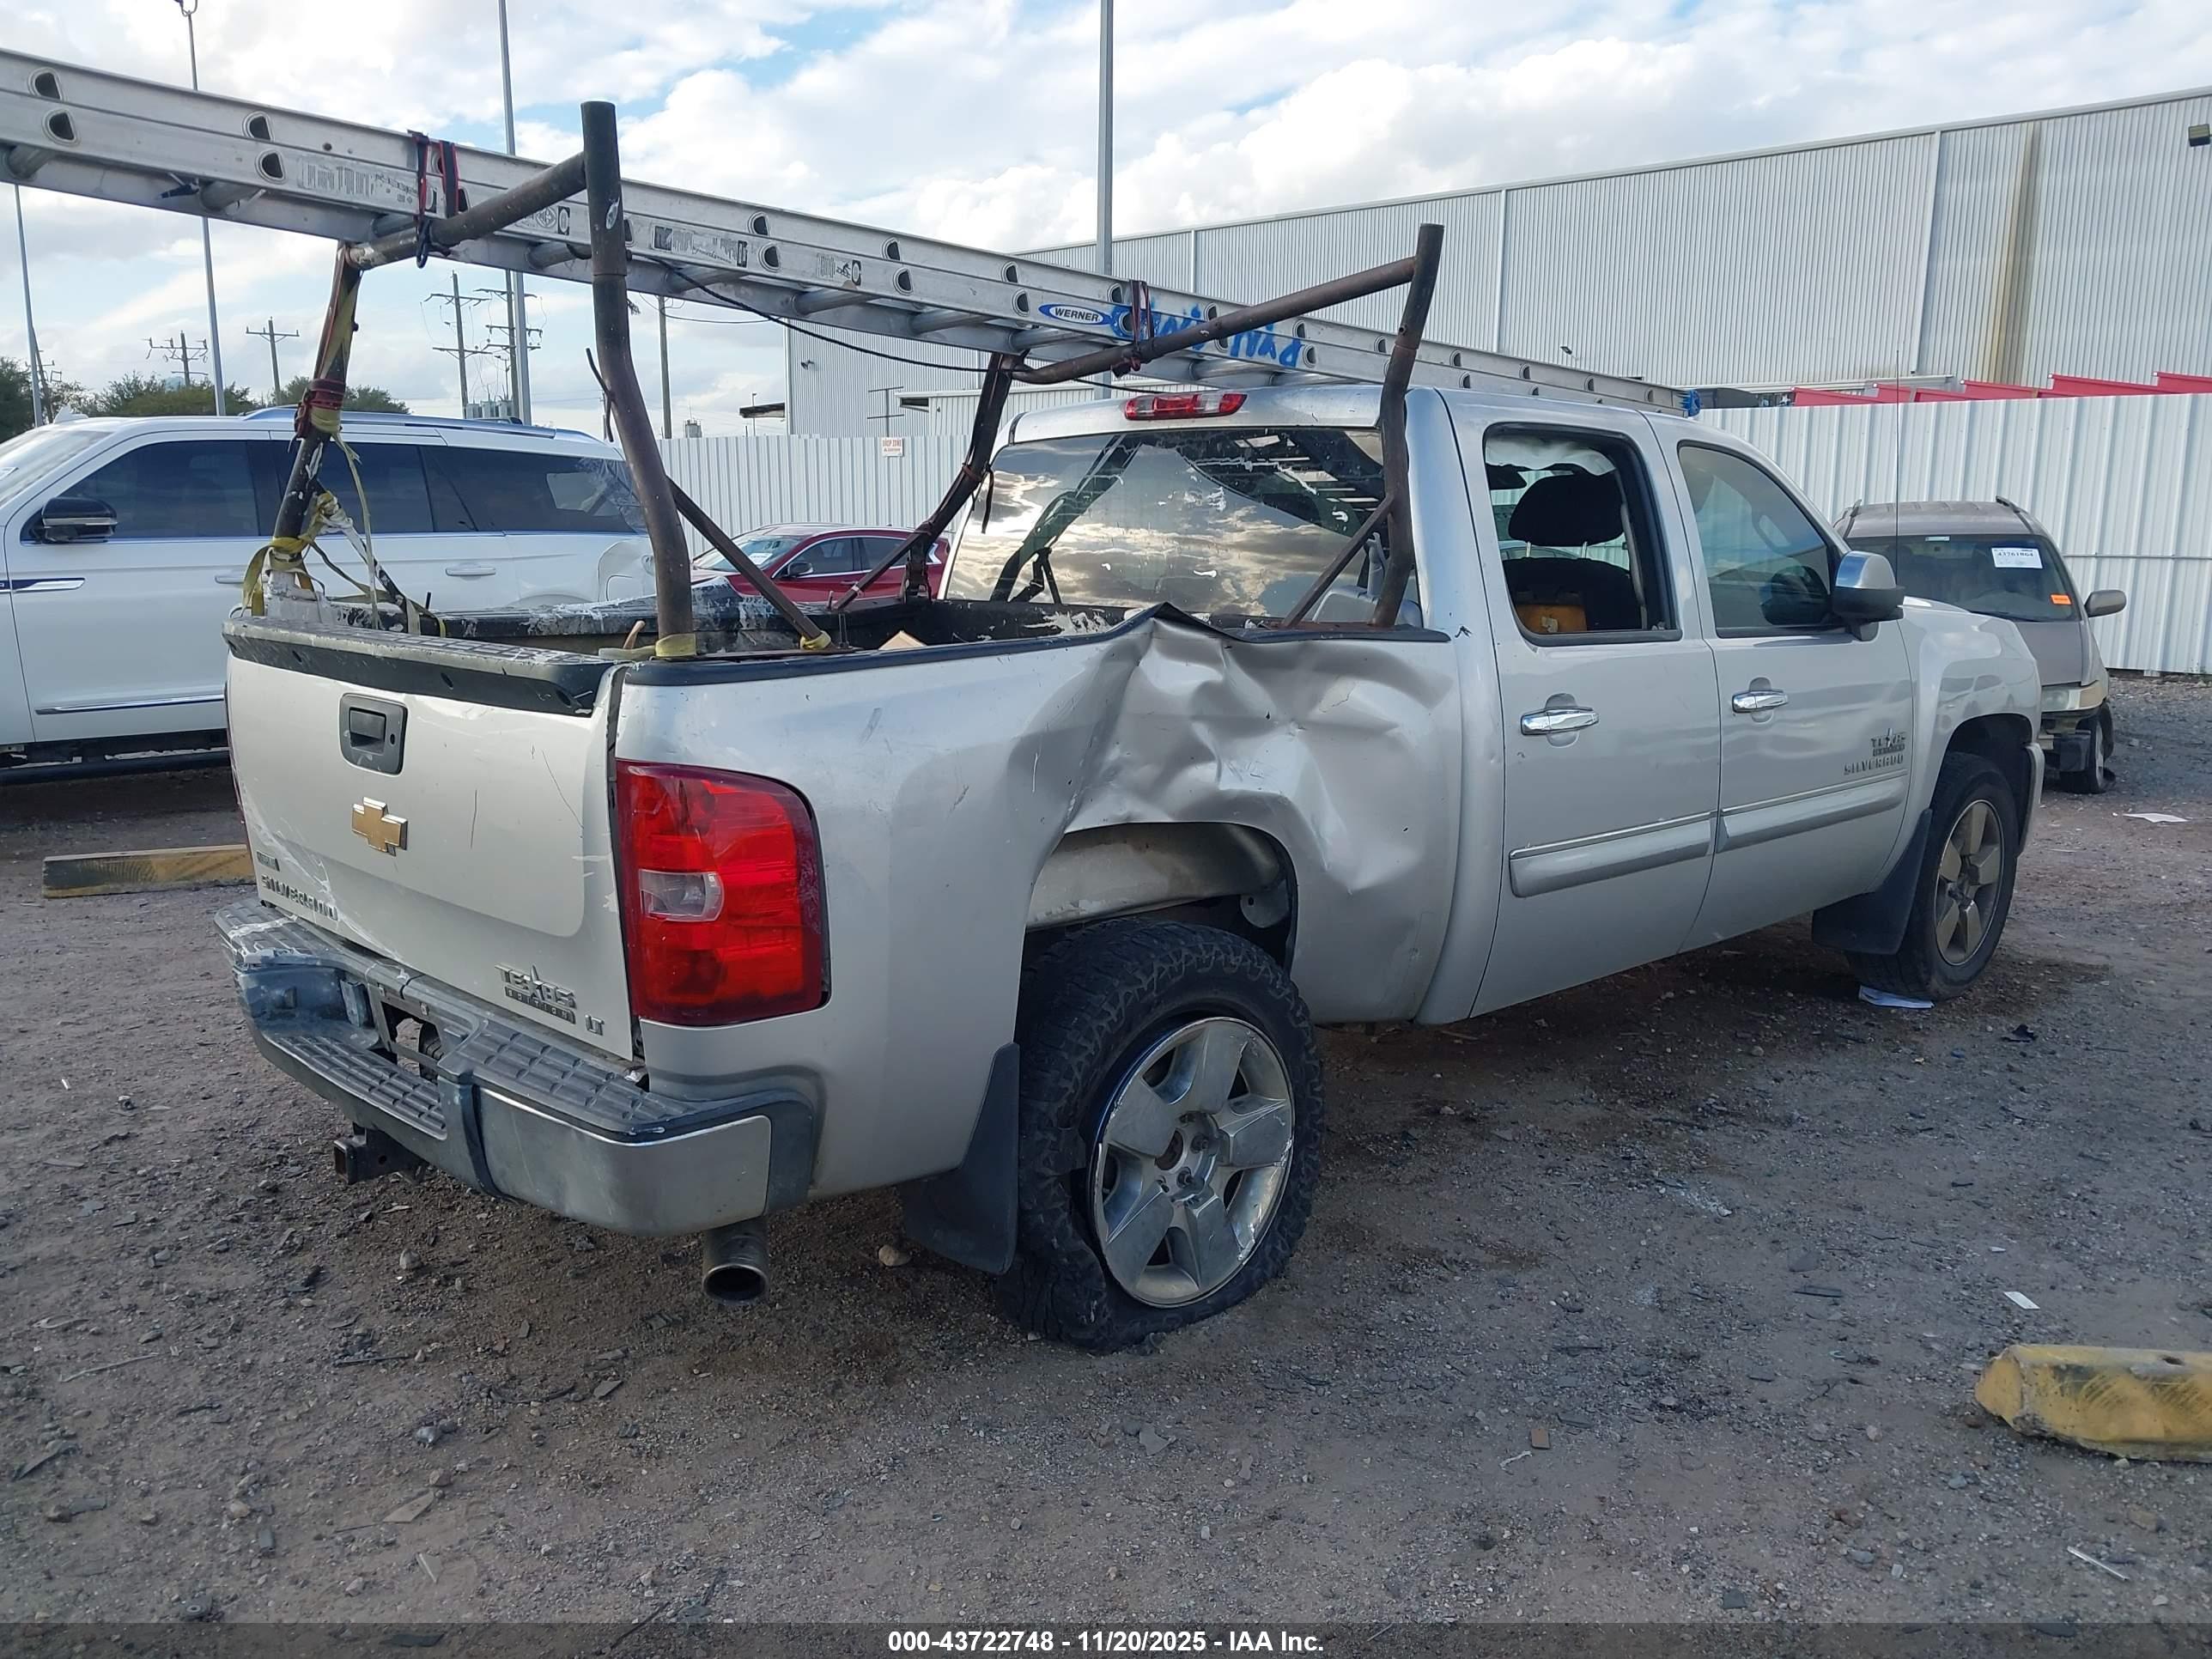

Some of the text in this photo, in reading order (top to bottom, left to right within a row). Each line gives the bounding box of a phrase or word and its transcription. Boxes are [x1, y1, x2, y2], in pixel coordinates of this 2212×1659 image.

[1054, 307, 1099, 322] WERNER
[1844, 754, 1904, 775] SILVERADO
[260, 873, 339, 921] SILVERADO
[495, 963, 577, 1010] TEXAS
[507, 988, 570, 1022] EDITION
[585, 1014, 605, 1036] LT
